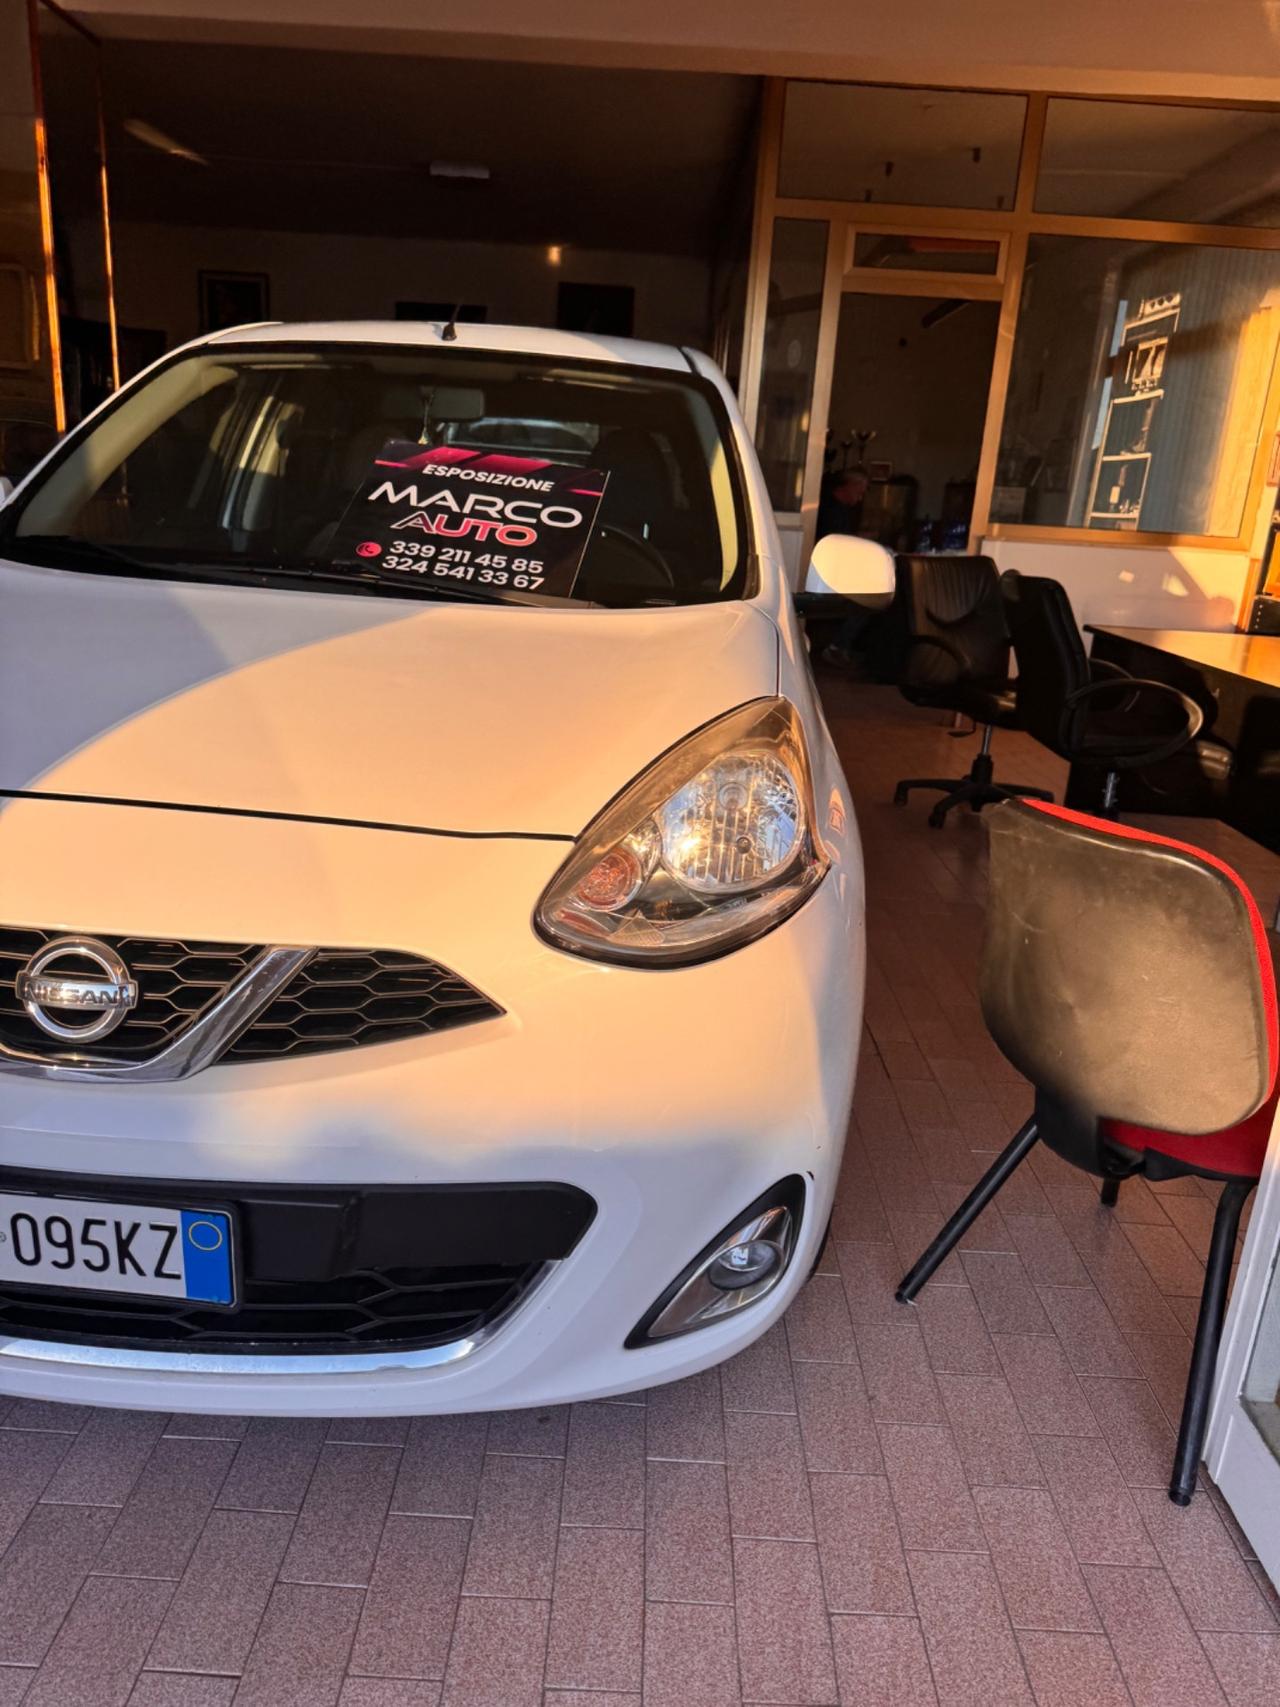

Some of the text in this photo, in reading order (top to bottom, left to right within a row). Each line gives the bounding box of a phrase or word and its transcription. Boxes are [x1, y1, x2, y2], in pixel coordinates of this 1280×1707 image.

[422, 463, 555, 492] ESPOSIZIONE
[368, 481, 583, 529] MARCO
[390, 511, 538, 547] AUTO
[382, 556, 545, 591] 324 541 33 67
[389, 541, 543, 574] 339 211 45 85
[24, 981, 120, 1005] NISSAN
[10, 1212, 182, 1279] 095KZ
